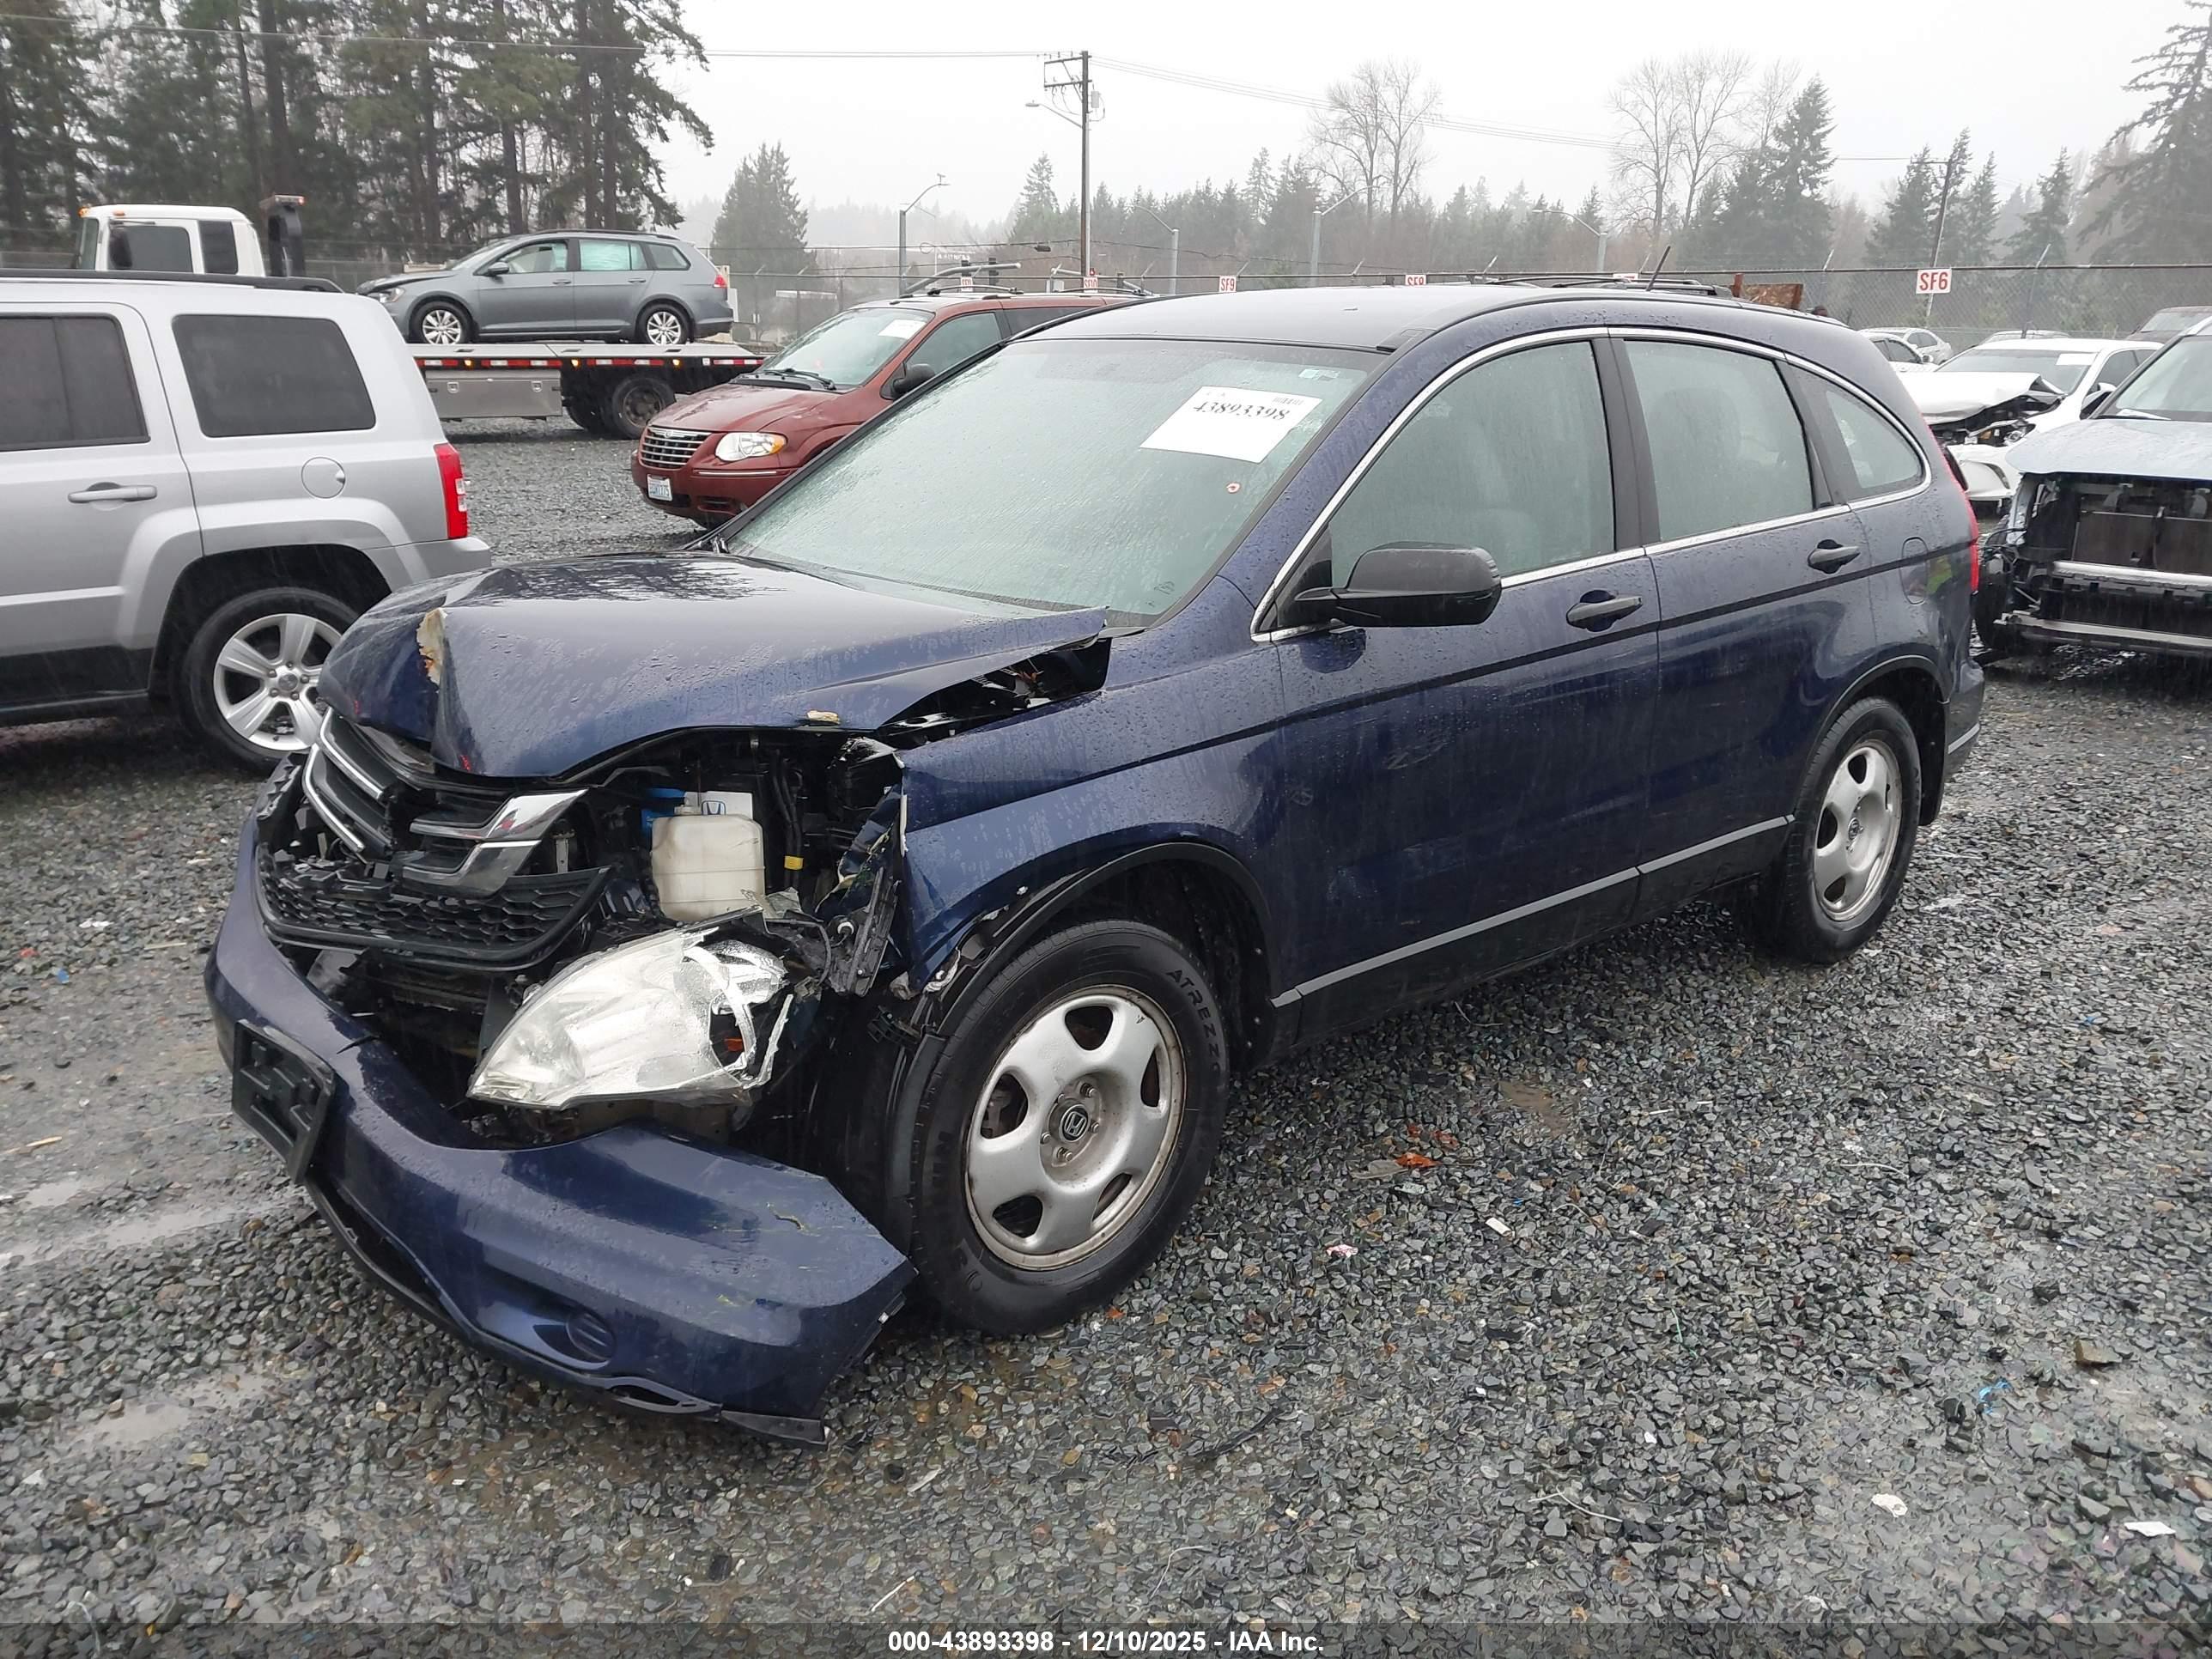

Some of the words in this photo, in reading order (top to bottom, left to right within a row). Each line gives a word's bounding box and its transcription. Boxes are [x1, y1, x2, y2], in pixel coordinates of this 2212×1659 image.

[1220, 277, 1235, 292] SF9
[1919, 271, 1948, 291] SF6
[1194, 401, 1291, 421] 43893398
